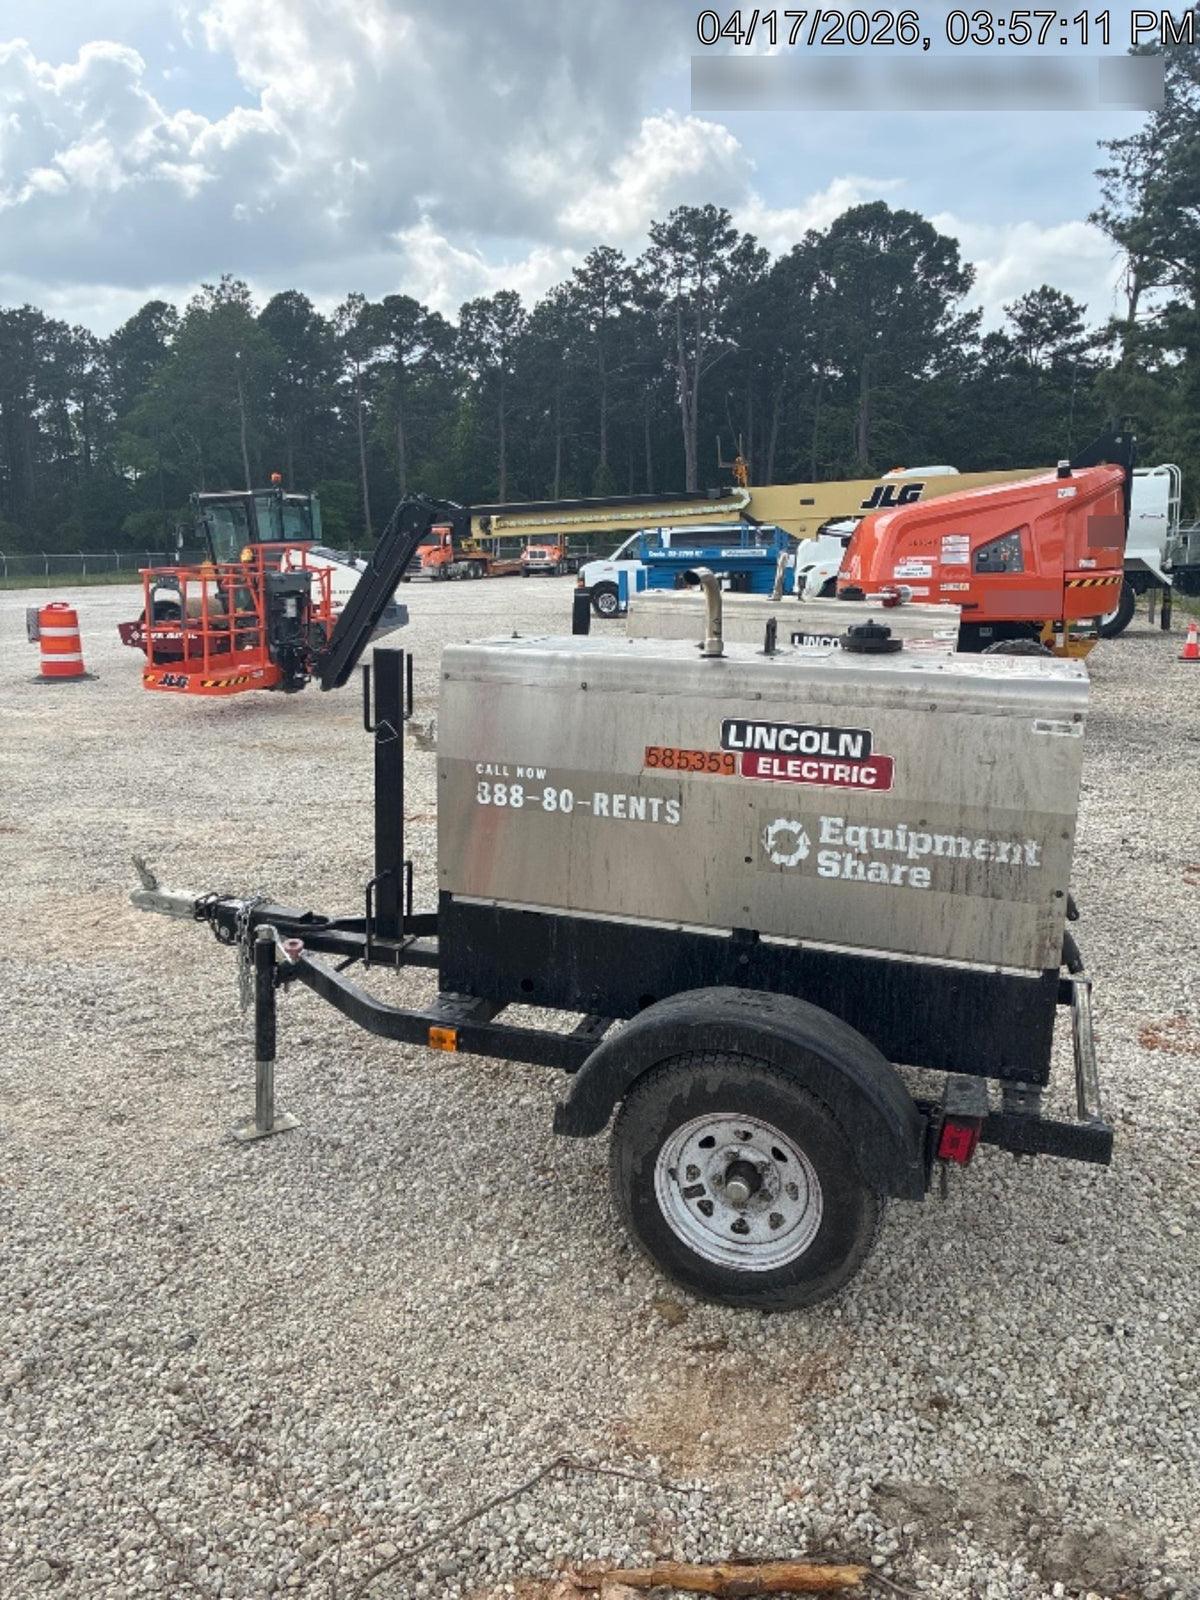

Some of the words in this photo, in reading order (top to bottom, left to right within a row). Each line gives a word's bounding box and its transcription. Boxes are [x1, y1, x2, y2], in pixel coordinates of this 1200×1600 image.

[859, 482, 927, 510] JLG
[793, 634, 843, 649] LINCO
[157, 672, 190, 689] JLG
[728, 724, 864, 759] LINCOLN
[475, 763, 510, 777] CALL
[516, 767, 548, 780] NOW
[645, 746, 737, 775] 585359
[756, 757, 878, 786] ELECTRIC
[818, 815, 1042, 868] Equipment
[817, 849, 932, 889] Share
